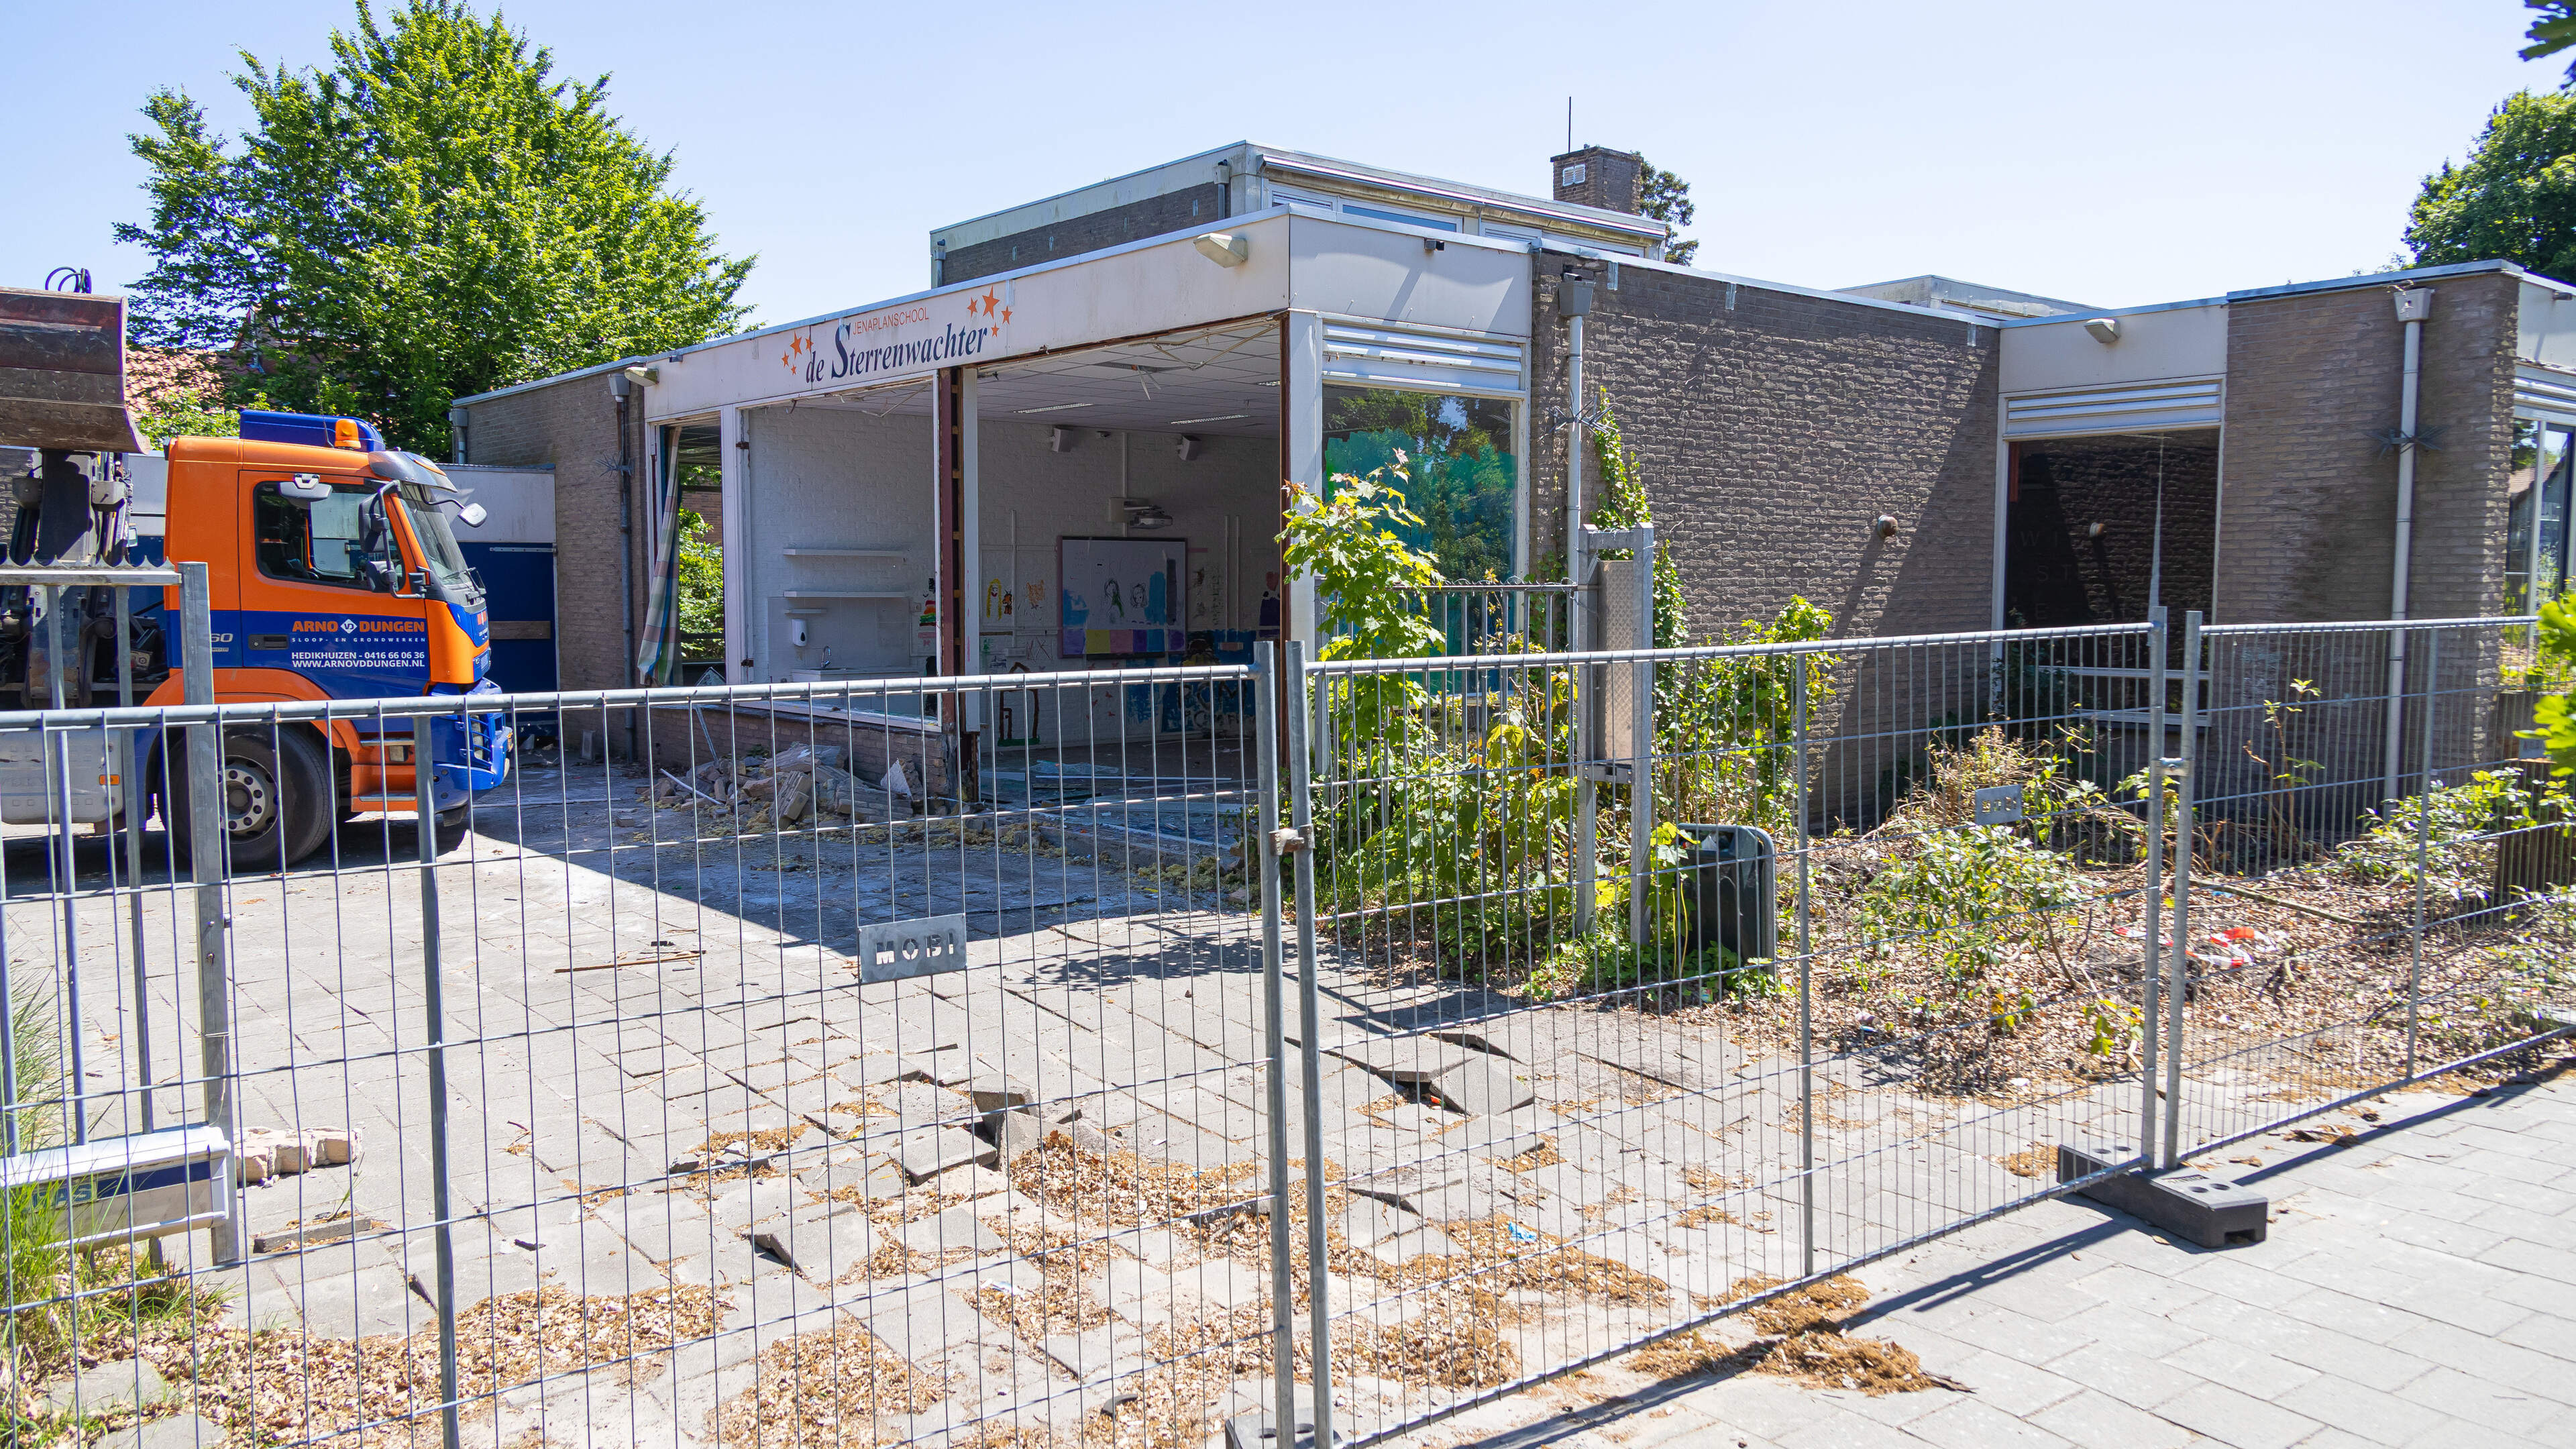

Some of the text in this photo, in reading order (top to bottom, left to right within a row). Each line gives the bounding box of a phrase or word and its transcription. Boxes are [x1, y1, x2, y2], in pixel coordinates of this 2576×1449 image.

[853, 307, 929, 335] JENAPLANSCHOOL
[806, 322, 988, 384] de Sterrenwachter
[292, 621, 338, 632] ARNO
[359, 621, 425, 632] DUNGEN
[875, 932, 955, 965] MOBI
